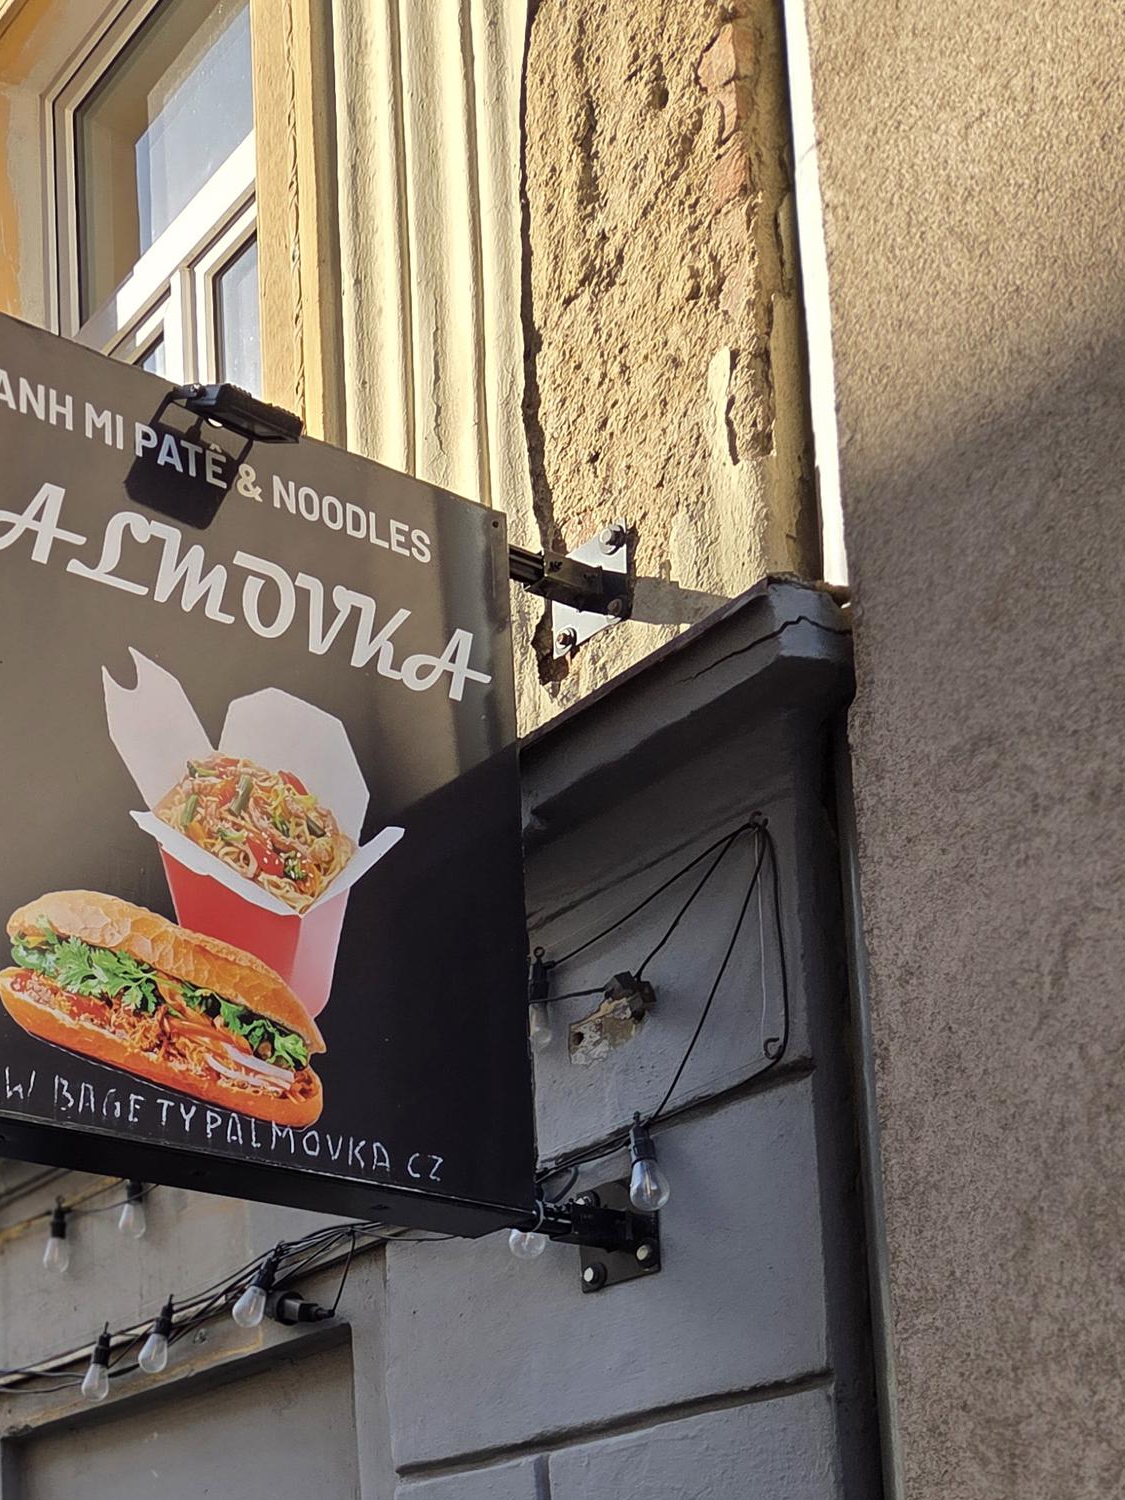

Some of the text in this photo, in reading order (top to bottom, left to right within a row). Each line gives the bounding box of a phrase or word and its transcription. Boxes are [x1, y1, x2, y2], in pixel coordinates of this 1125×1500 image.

[84, 402, 124, 450] MI
[236, 464, 263, 502] &
[272, 476, 432, 564] NOODLES
